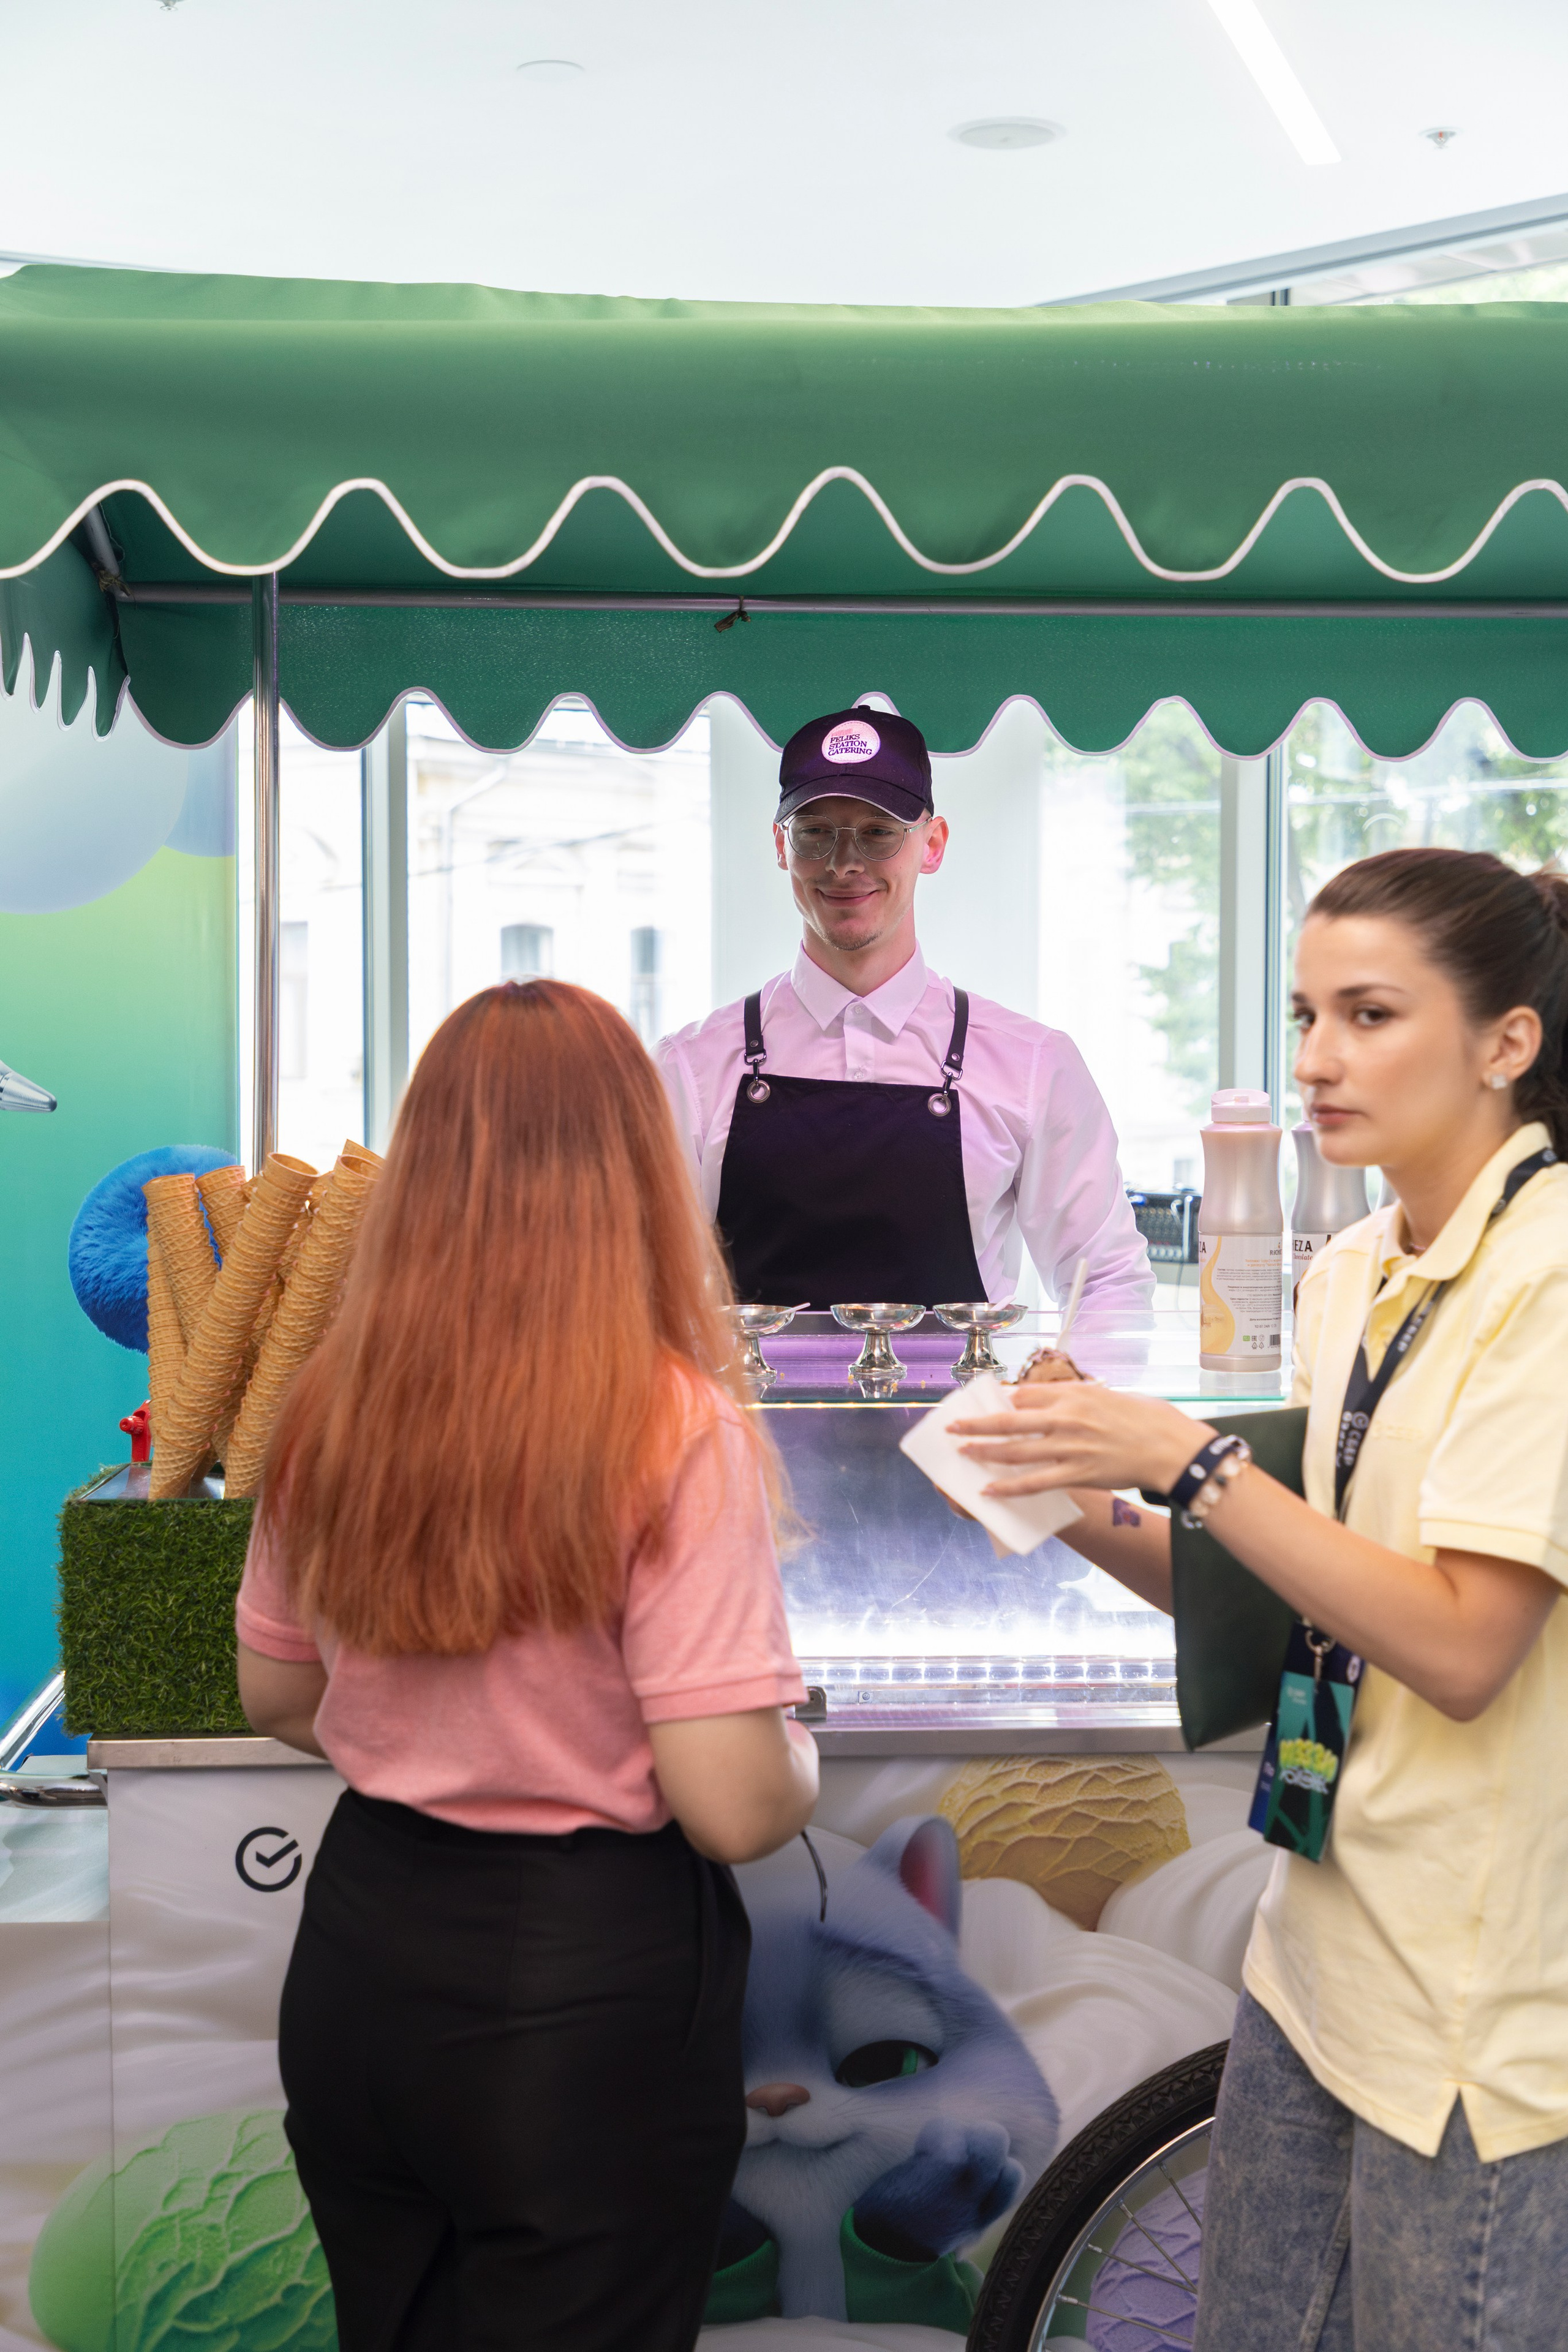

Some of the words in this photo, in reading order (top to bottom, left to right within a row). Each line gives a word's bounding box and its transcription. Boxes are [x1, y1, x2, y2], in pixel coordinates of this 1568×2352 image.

[830, 734, 860, 743] FELIKS
[829, 741, 867, 750] STATION
[828, 747, 872, 756] CATERING
